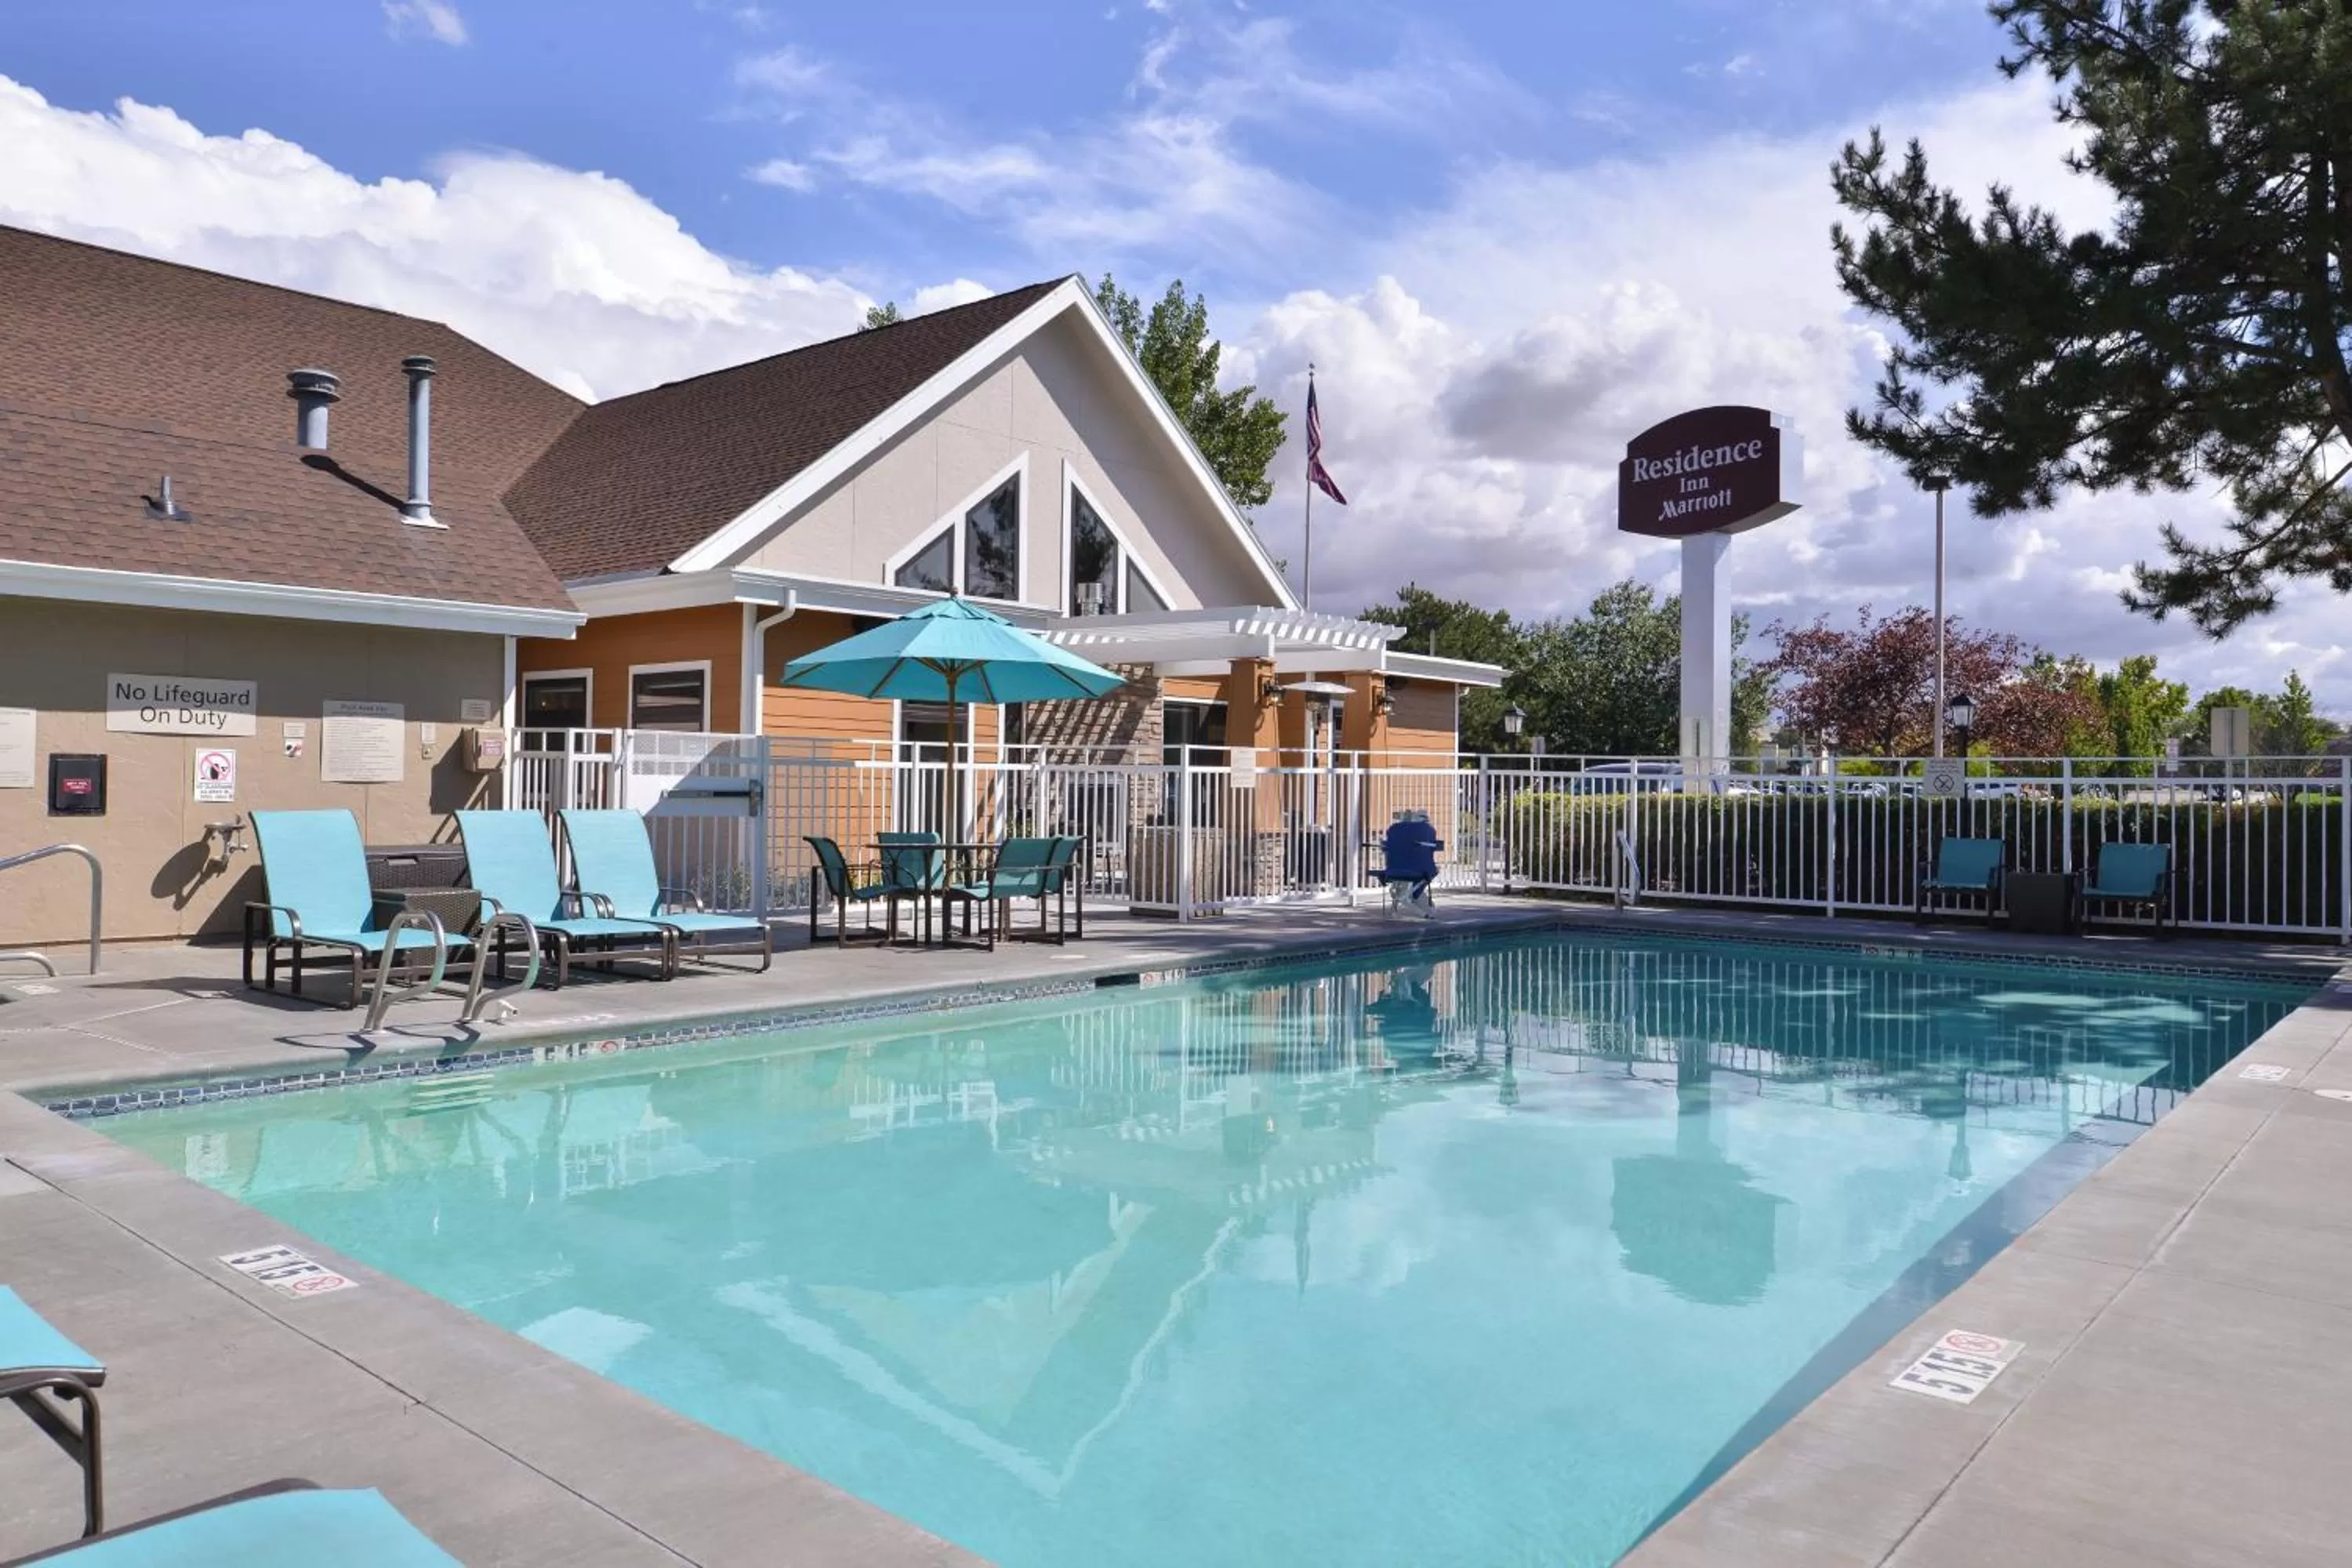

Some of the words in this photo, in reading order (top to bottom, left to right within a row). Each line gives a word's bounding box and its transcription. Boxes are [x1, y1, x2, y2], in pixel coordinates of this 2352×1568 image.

[1632, 439, 1762, 483] Residence
[1680, 476, 1710, 493] Inn
[1658, 489, 1732, 521] Marriott
[115, 683, 146, 700] No
[154, 684, 250, 707] Lifeguard
[140, 706, 170, 723] On
[179, 708, 227, 730] Duty
